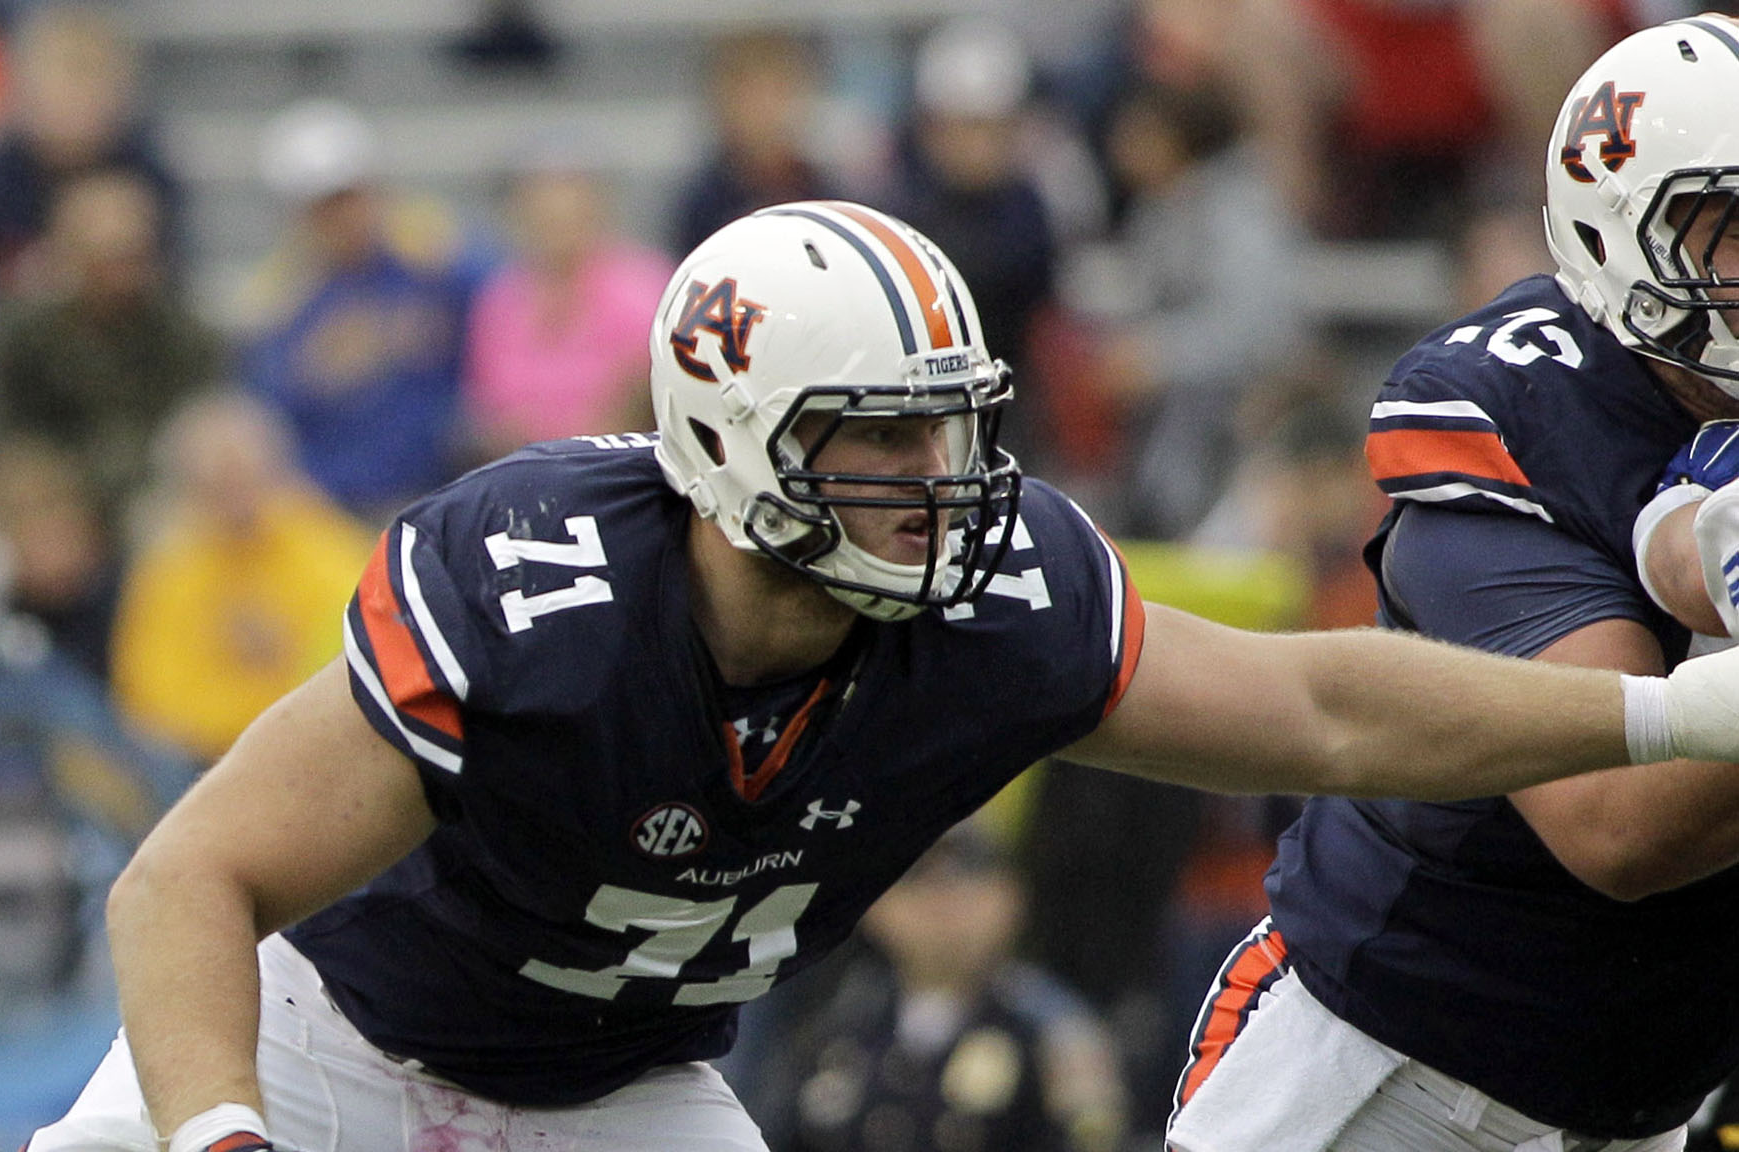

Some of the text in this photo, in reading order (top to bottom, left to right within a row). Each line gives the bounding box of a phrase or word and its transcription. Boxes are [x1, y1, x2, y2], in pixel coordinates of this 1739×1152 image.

[925, 353, 969, 376] TIGERS
[484, 515, 614, 634] 71
[636, 807, 703, 856] SEC
[675, 850, 804, 886] AUBURN
[518, 882, 820, 1006] 71
